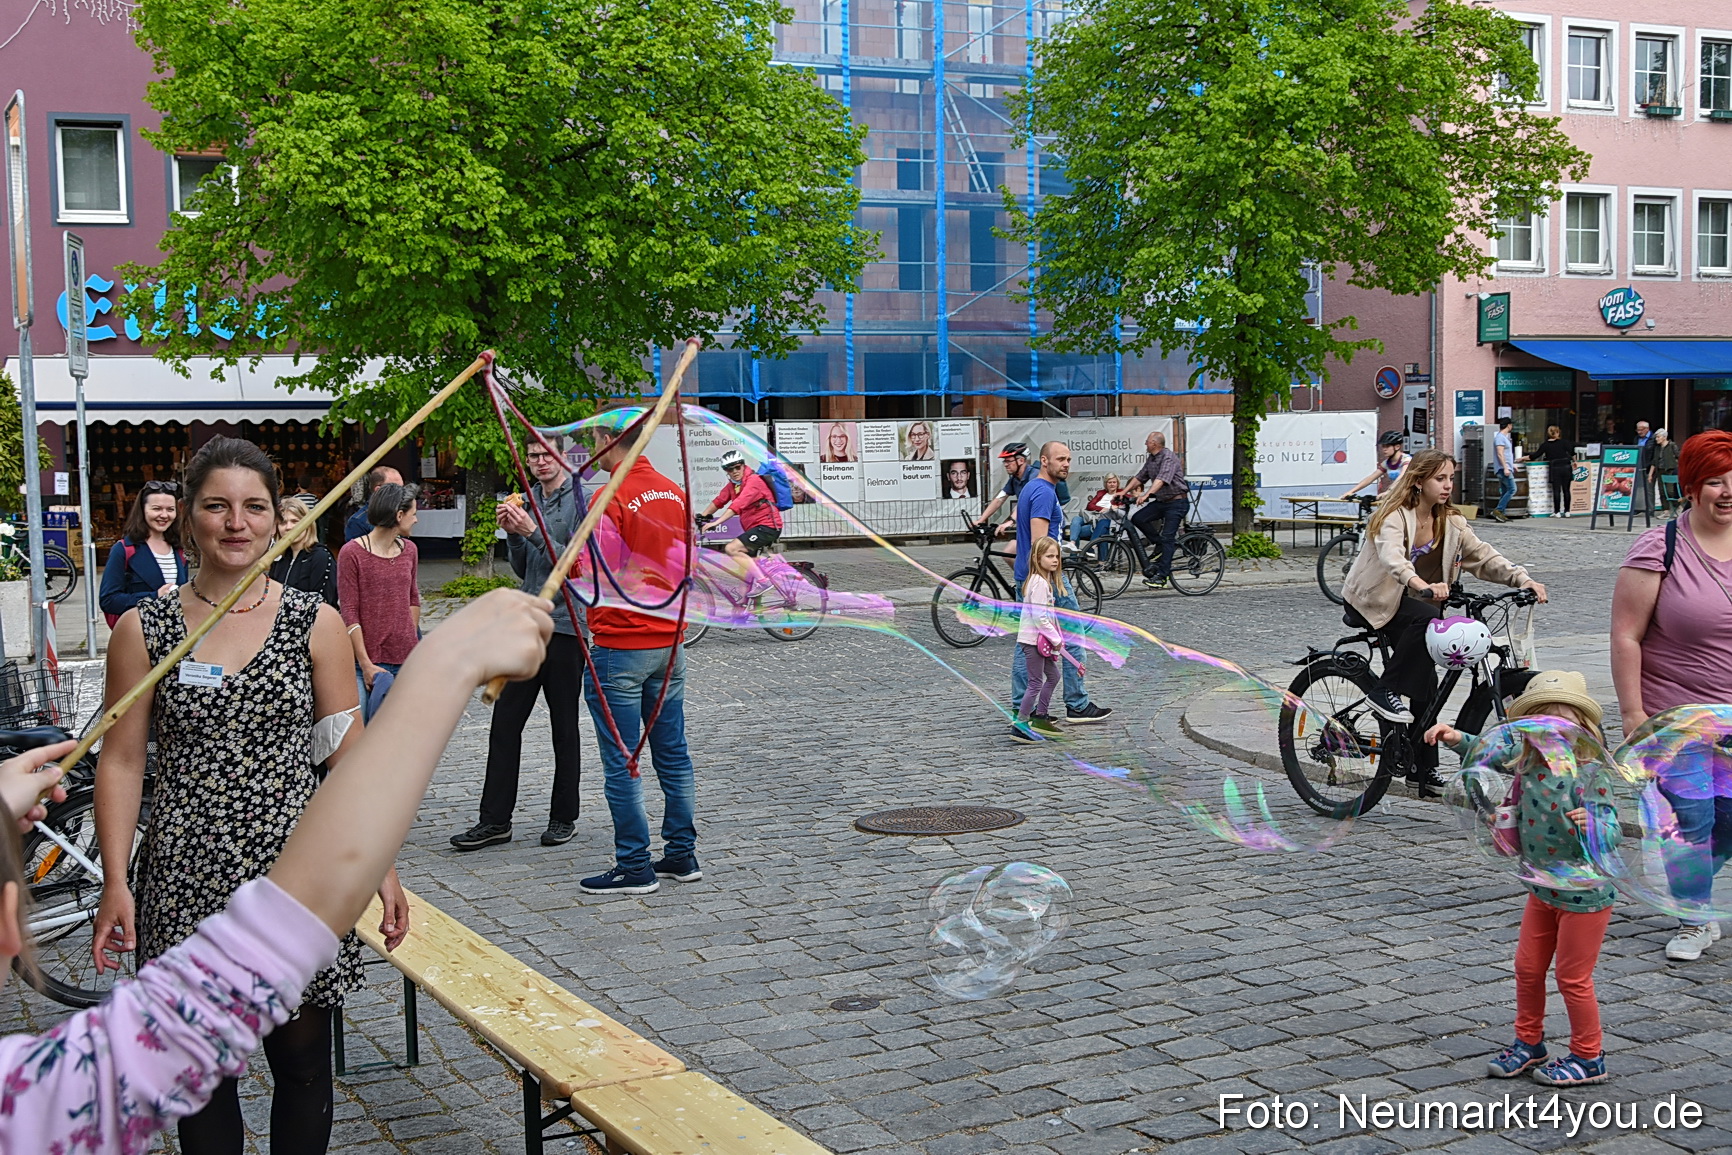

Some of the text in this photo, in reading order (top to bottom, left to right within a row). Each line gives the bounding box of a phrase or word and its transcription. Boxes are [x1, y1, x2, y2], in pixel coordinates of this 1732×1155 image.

[1600, 292, 1624, 310] vom
[1484, 303, 1496, 313] vom
[1487, 305, 1505, 320] FASS
[1606, 299, 1644, 325] FASS
[1499, 375, 1571, 389] Spirituosen Whisky
[689, 429, 712, 437] Fuchs
[722, 438, 745, 446] GmbH
[1078, 453, 1133, 465] neumarkt
[1281, 452, 1315, 462] Nutz
[1574, 470, 1590, 481] FASS
[867, 478, 898, 486] fielmann
[627, 497, 642, 513] SV
